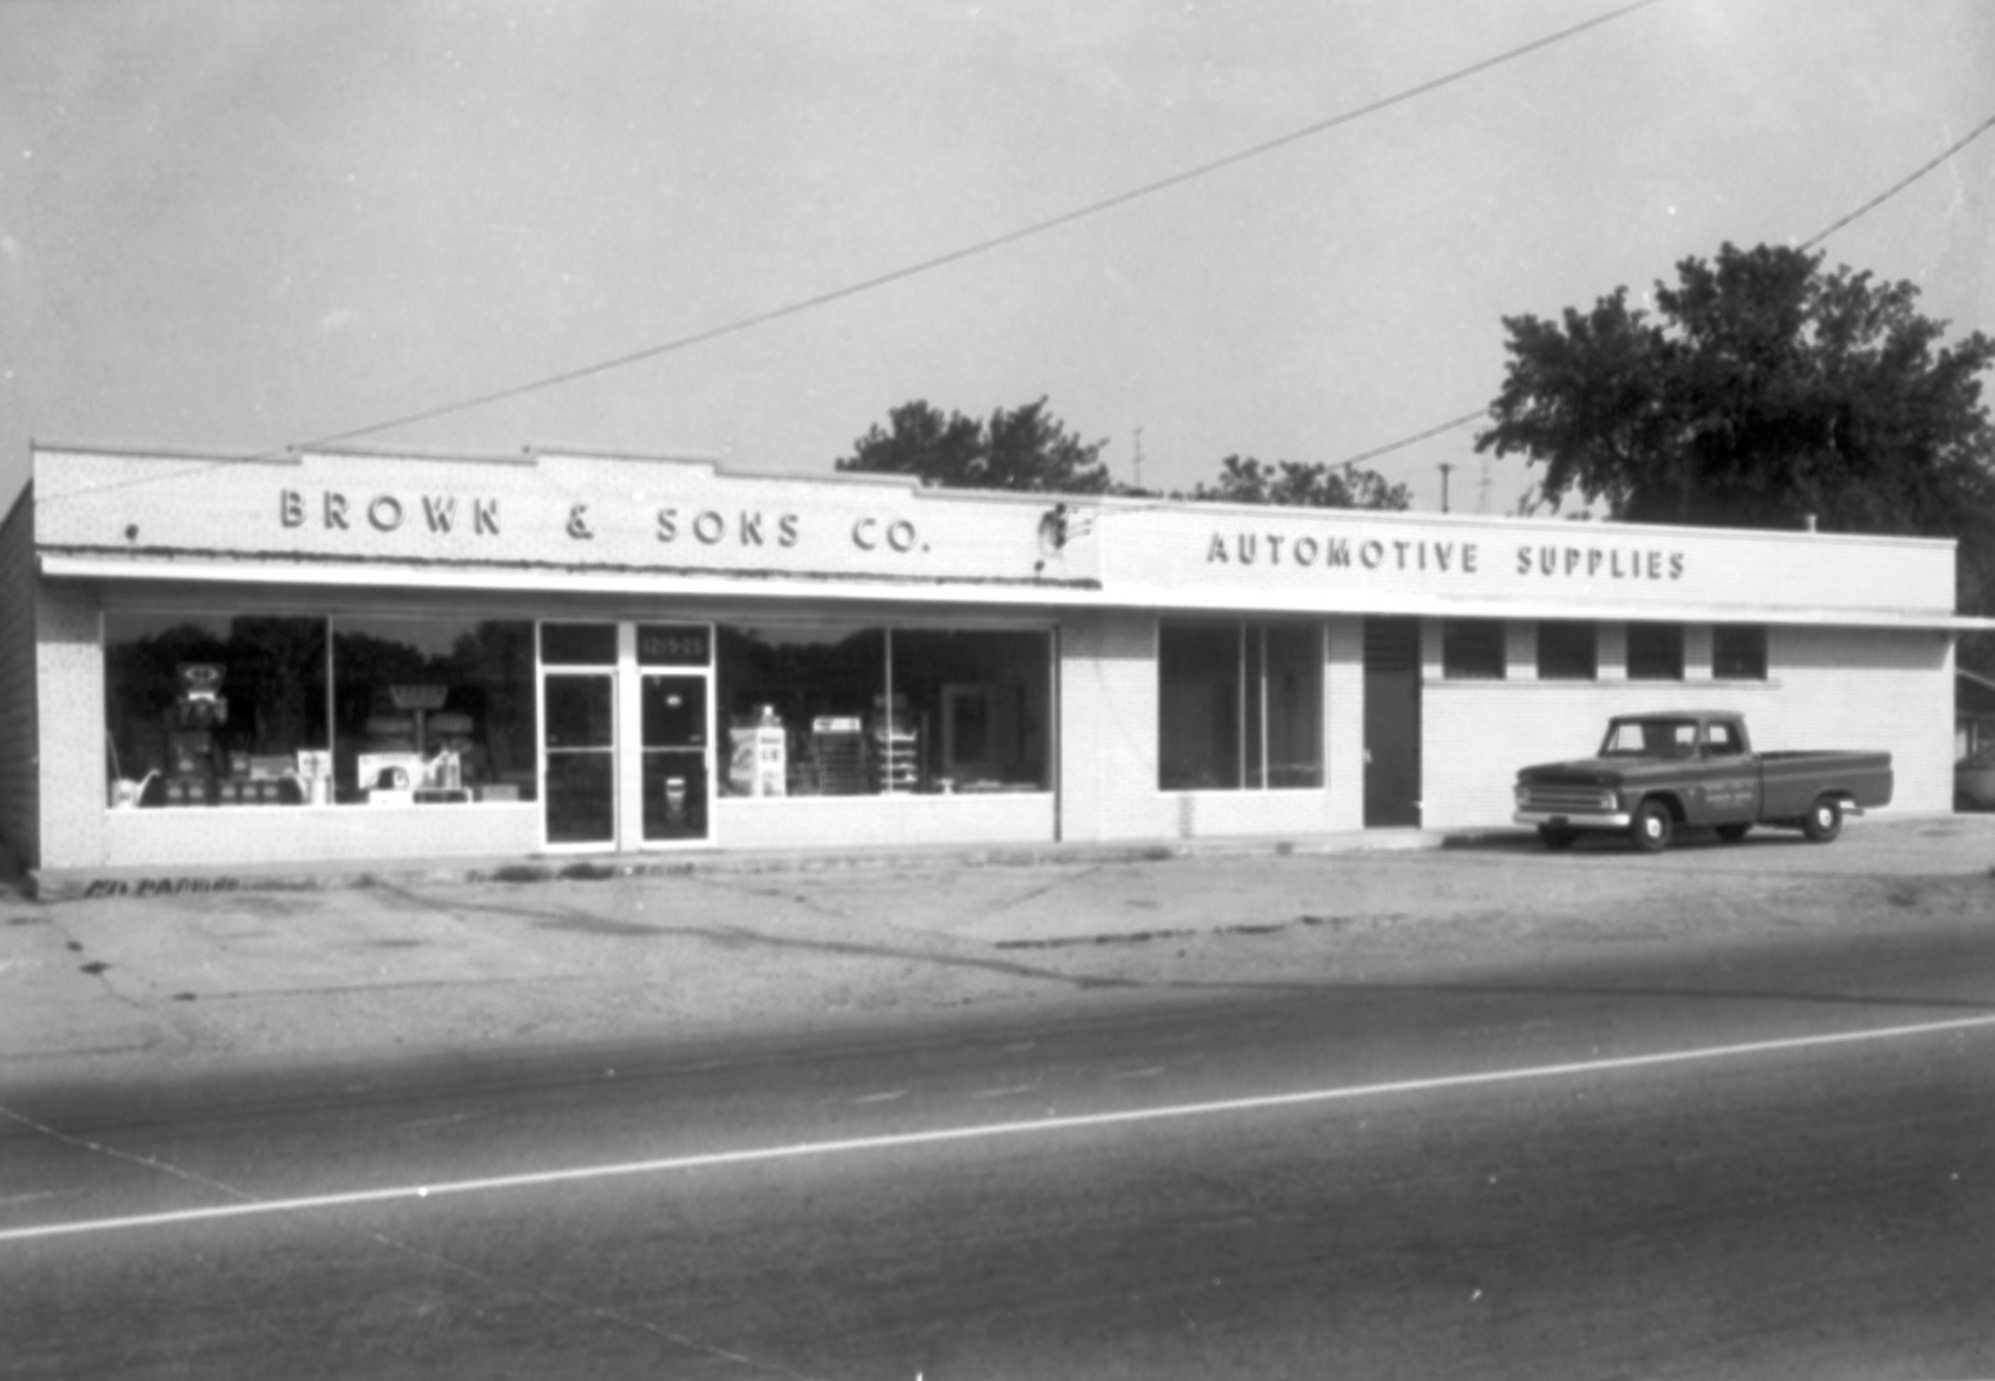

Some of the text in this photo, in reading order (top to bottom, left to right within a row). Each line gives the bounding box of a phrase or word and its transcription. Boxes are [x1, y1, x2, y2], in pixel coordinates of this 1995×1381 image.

[280, 489, 930, 553] BROWN & SONS CO.
[1206, 534, 1683, 580] AUTOMOTIVE SUPPLIES
